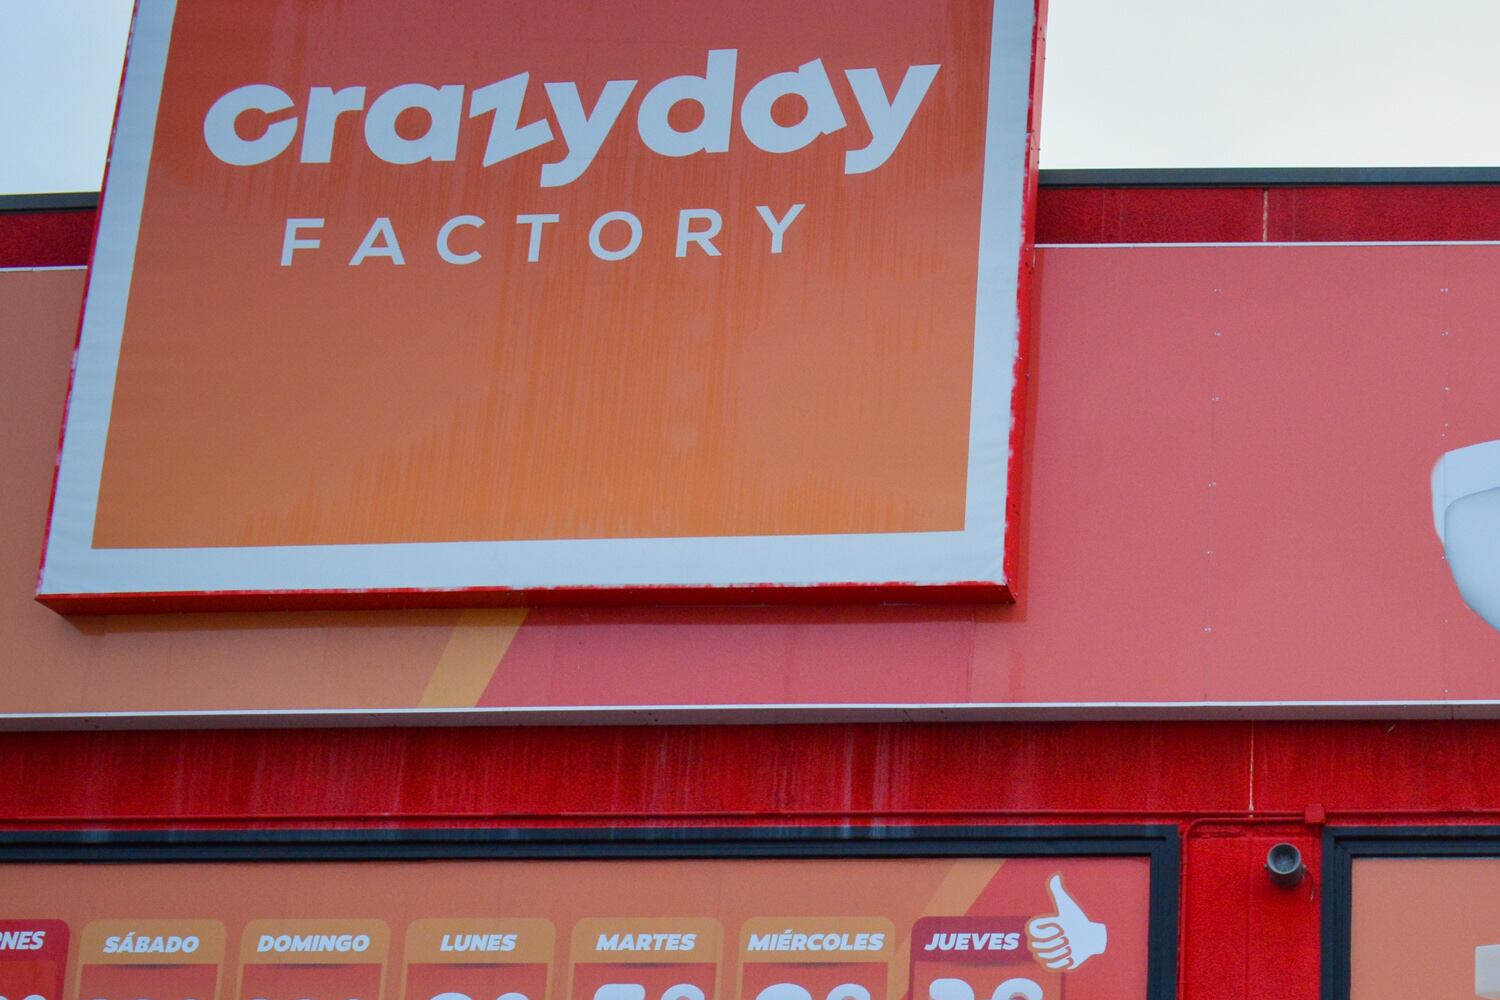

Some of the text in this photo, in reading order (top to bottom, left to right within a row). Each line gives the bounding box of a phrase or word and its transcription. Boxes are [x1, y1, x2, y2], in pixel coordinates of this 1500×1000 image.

[203, 48, 941, 188] crazyday
[280, 203, 806, 266] FACTORY
[103, 931, 200, 954] SÁBADO
[256, 934, 371, 953] DOMINGO
[439, 933, 518, 952] LUNES
[595, 932, 697, 952] MARTES
[747, 928, 886, 952] MIÉRCOLES
[924, 932, 1021, 951] JUEVES
